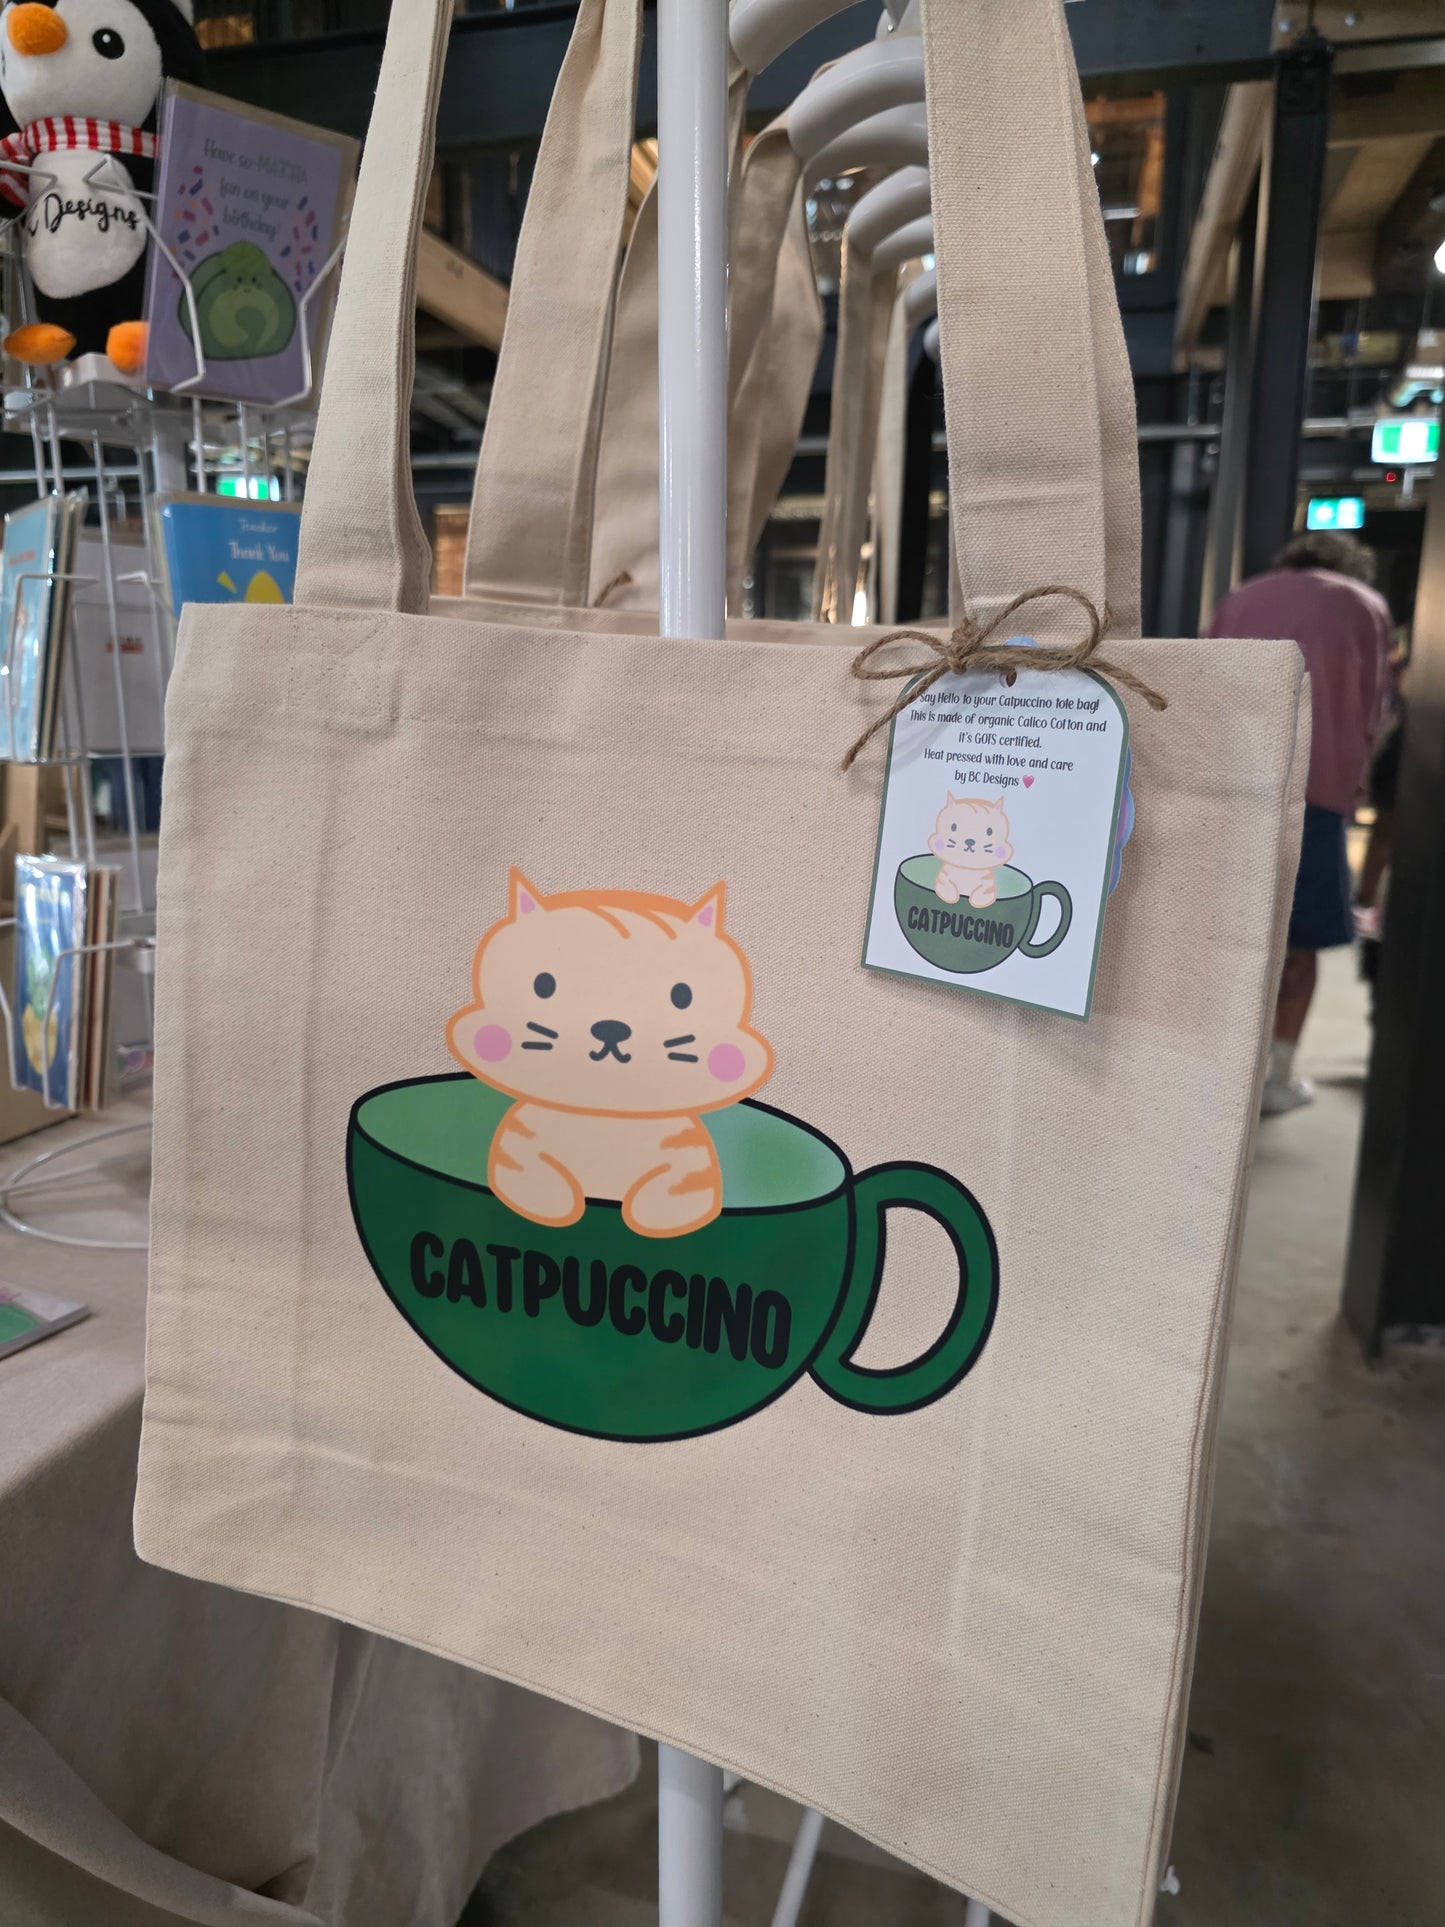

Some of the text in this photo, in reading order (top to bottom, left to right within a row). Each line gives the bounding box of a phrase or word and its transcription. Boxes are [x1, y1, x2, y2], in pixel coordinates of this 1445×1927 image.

[44, 193, 139, 233] Designs
[228, 540, 289, 563] Thank You
[920, 692, 1100, 714] Say Hello to your Catpuccino tote bag!
[910, 709, 1107, 733] This is made of organic Calico Cotton and
[974, 732, 997, 745] GOTS
[998, 735, 1042, 749] certified.
[924, 747, 1074, 772] Heat pressed with love and care
[954, 769, 1020, 789] by BC Designs
[907, 905, 1015, 949] CATPUCCINO
[409, 1230, 793, 1371] CATPUCCINO
